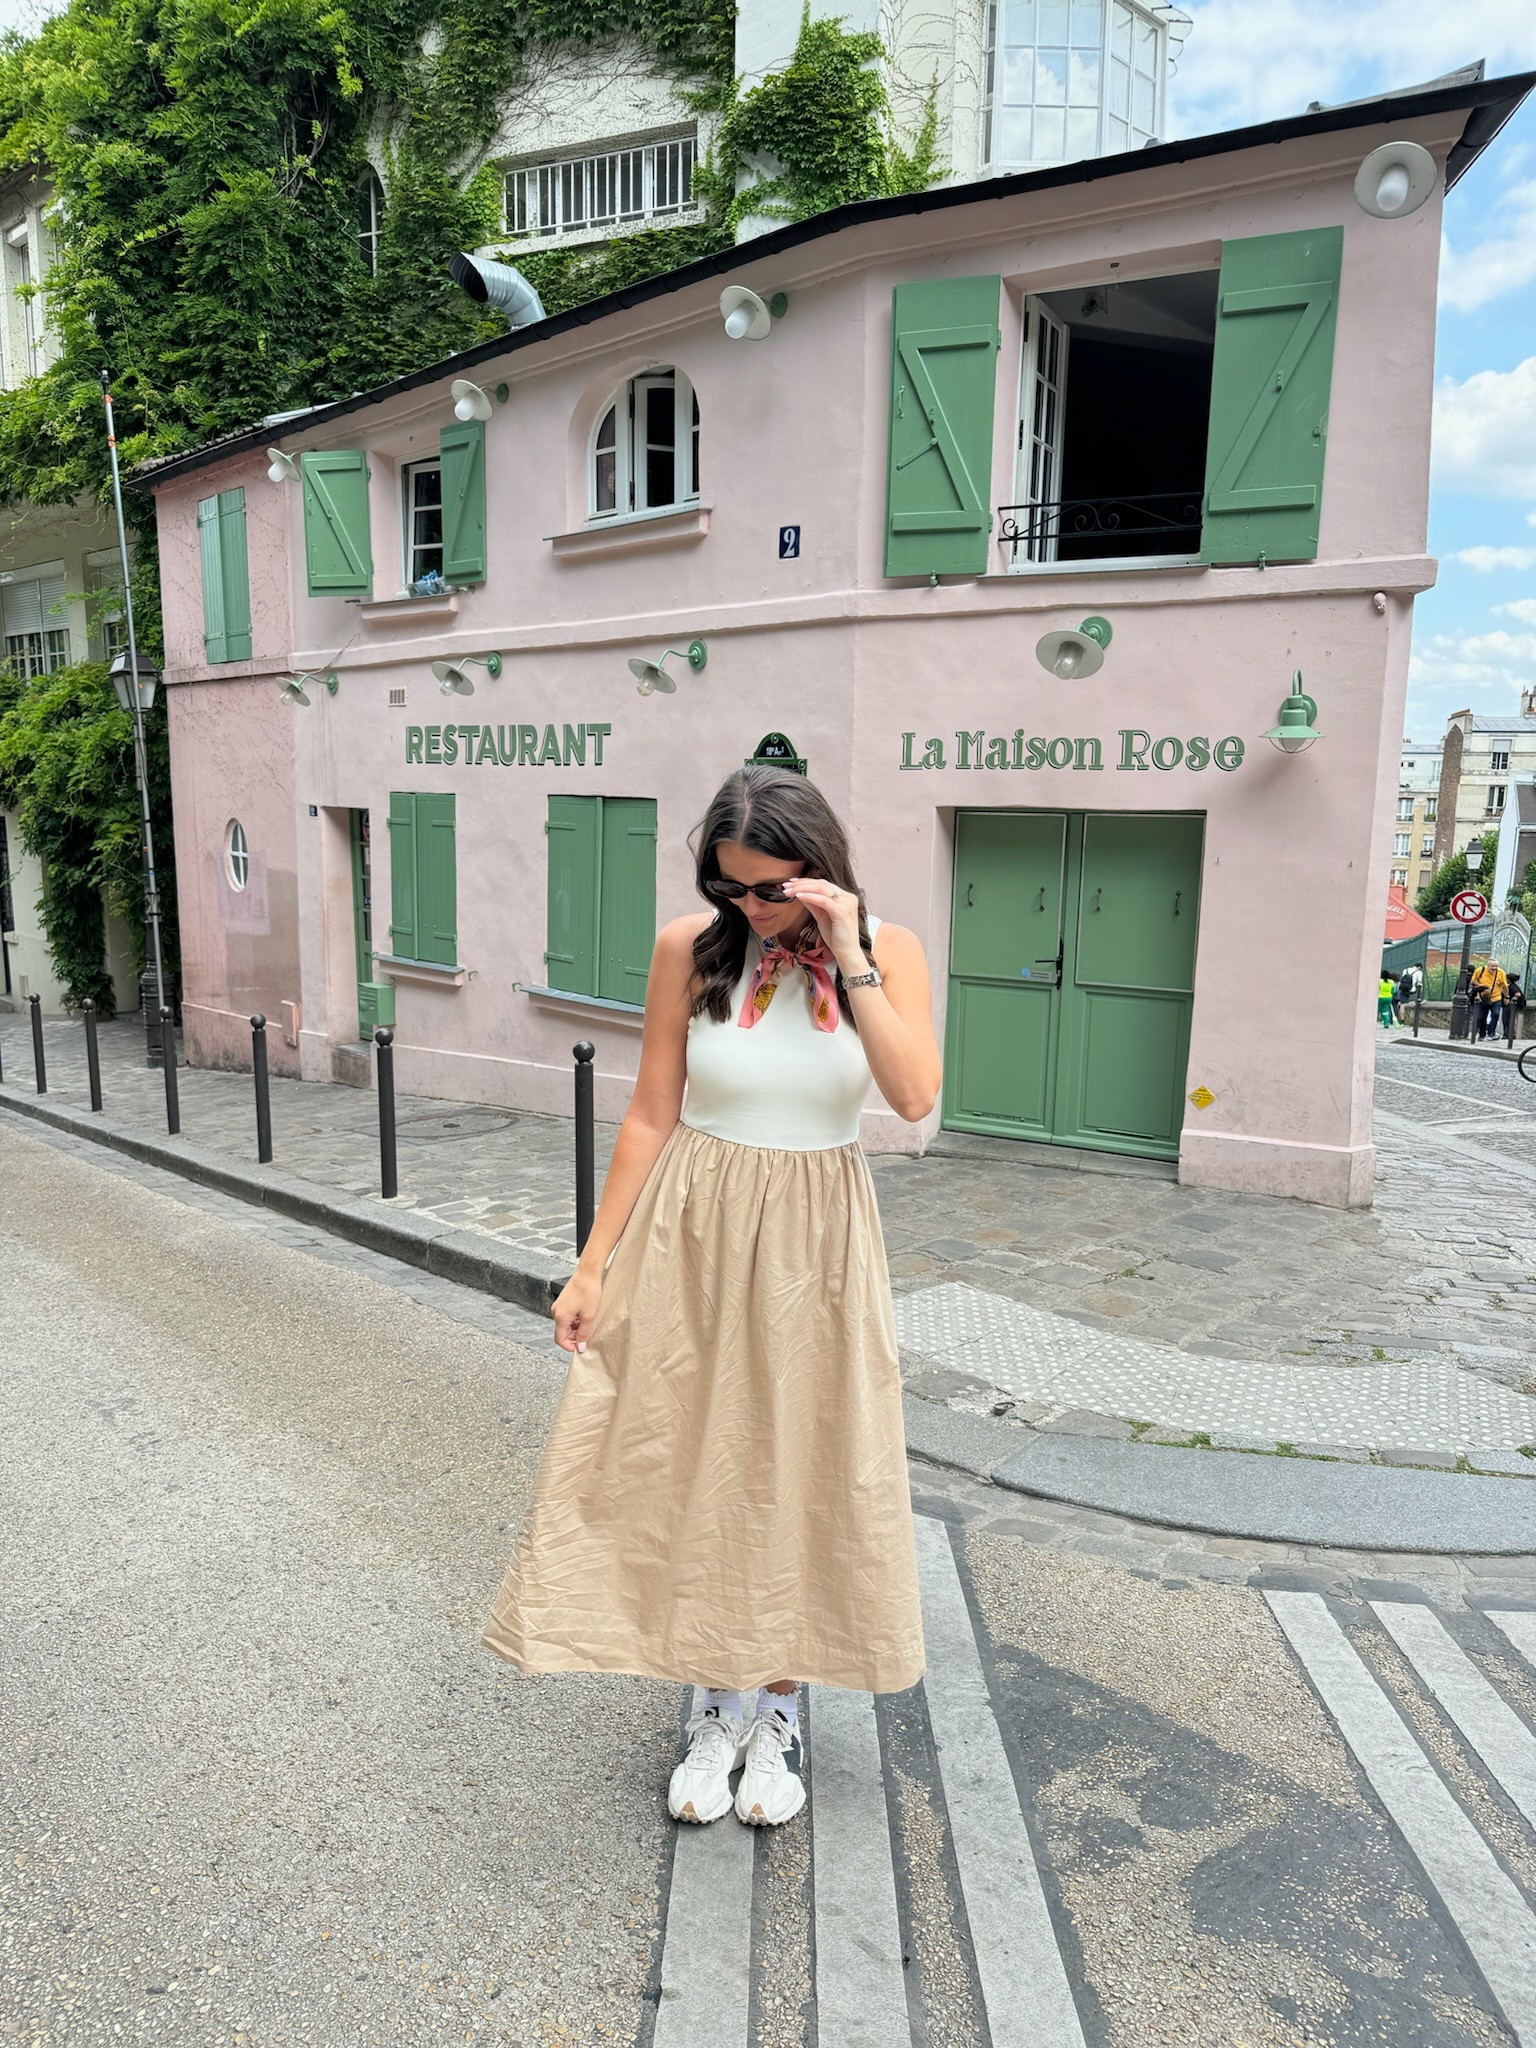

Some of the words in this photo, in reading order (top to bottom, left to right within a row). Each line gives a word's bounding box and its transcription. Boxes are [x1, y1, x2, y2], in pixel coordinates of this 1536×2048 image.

[783, 528, 795, 557] 2
[406, 723, 612, 766] RESTAURANT
[899, 731, 947, 770] La
[955, 728, 1104, 771] Maison
[1116, 729, 1246, 771] Rose
